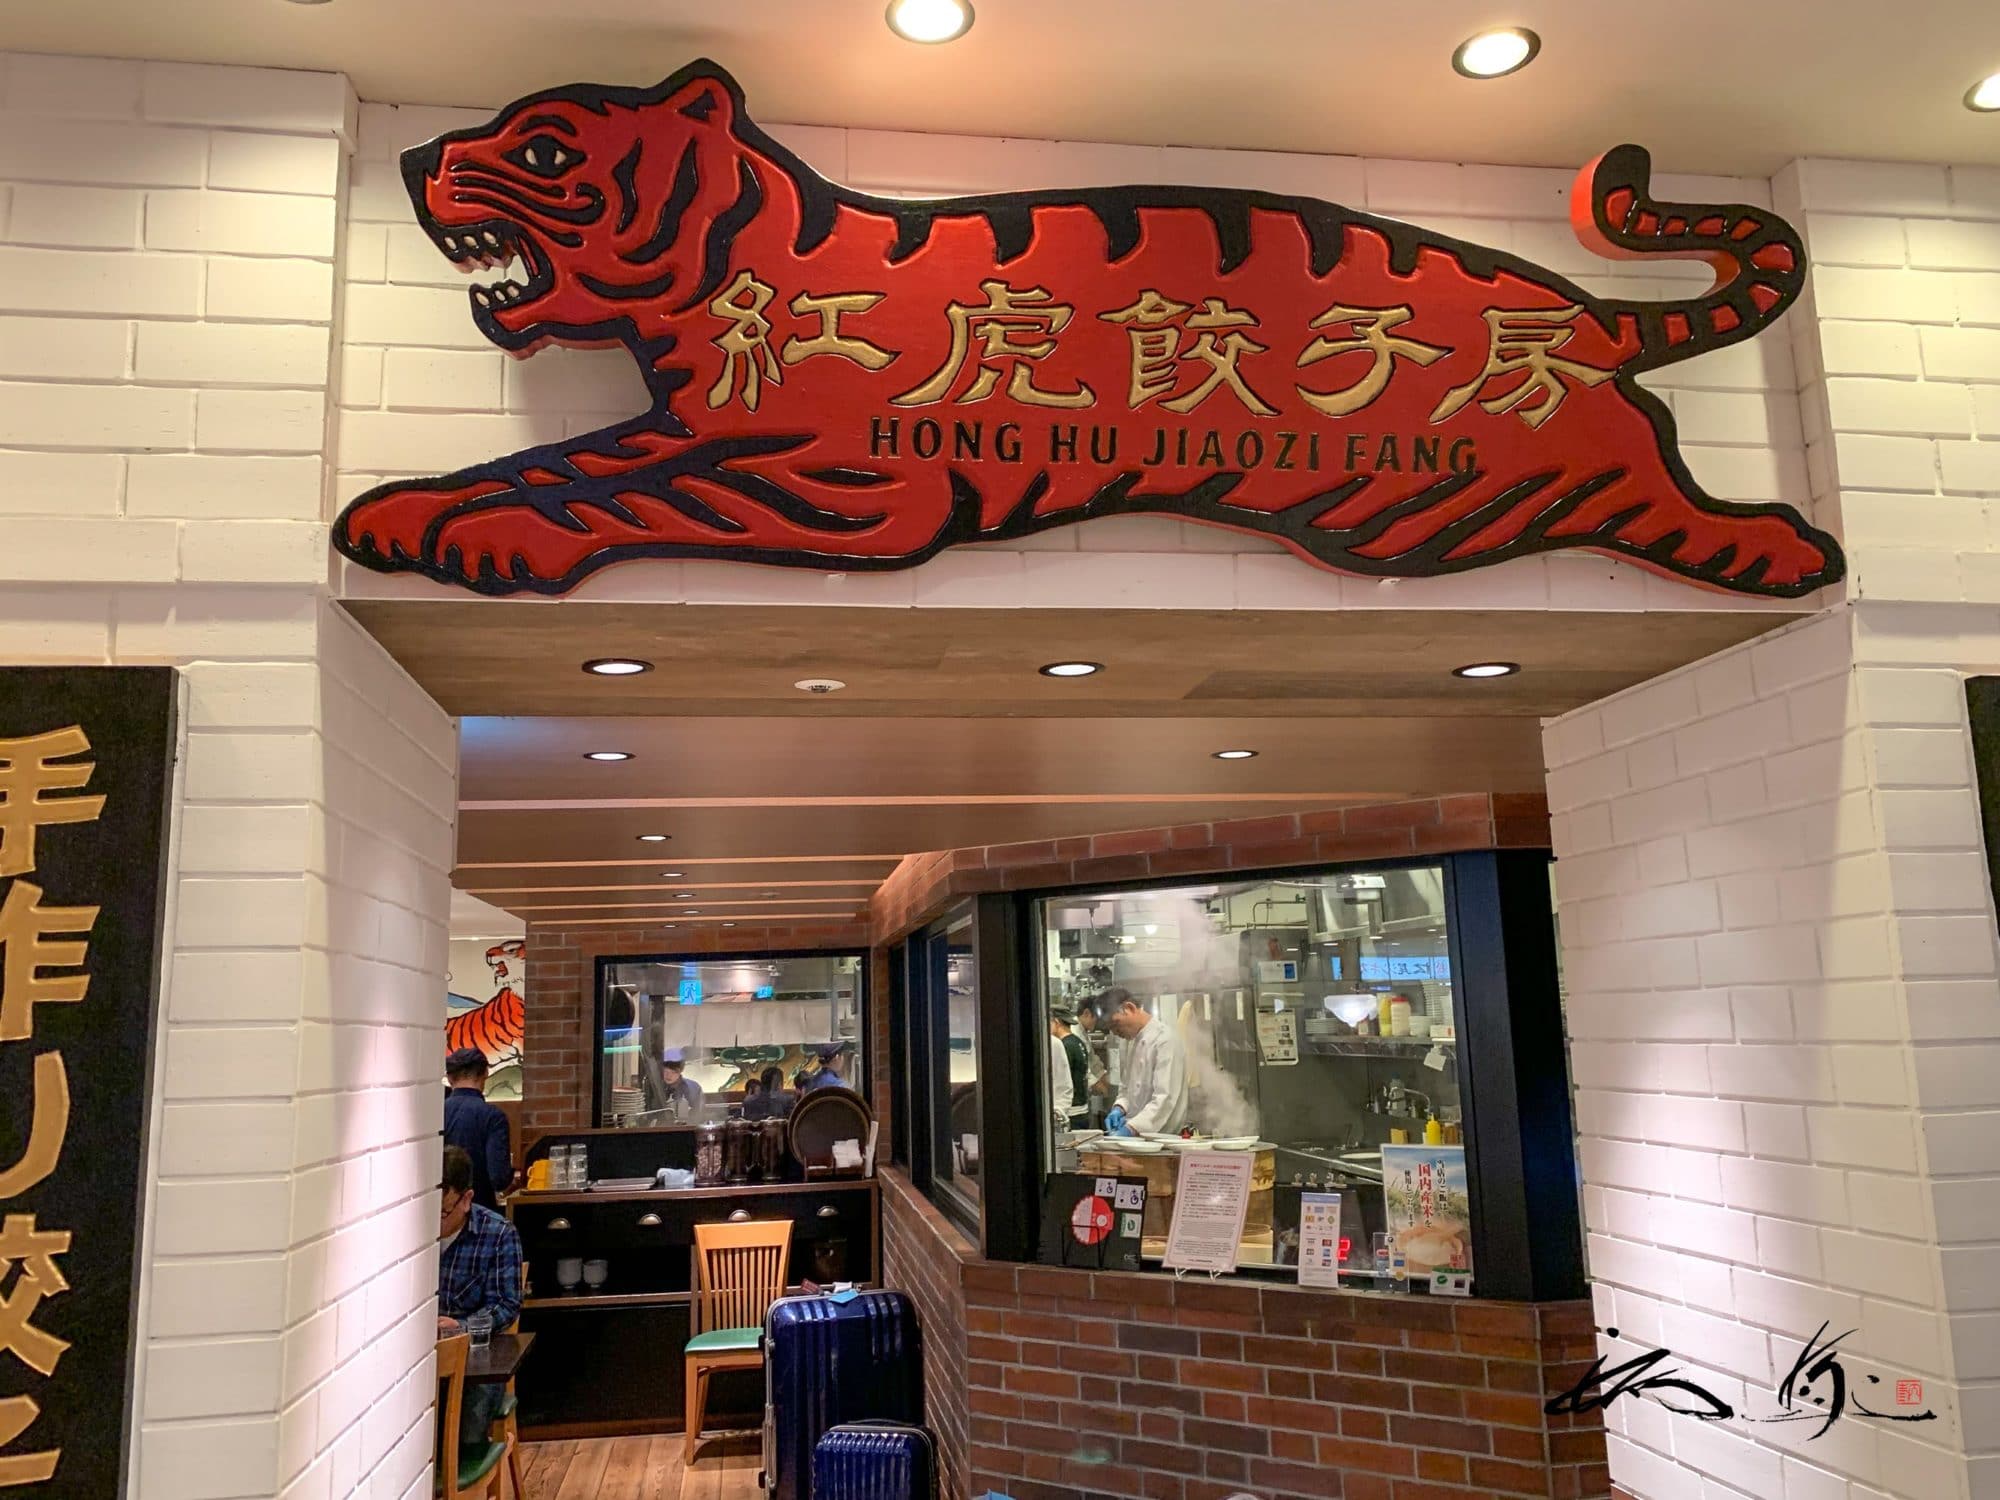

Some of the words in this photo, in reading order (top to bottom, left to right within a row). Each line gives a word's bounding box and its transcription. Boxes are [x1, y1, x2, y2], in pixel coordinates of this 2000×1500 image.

[706, 270, 1616, 430] 紅虎餃子房
[869, 417, 1024, 464] HONG
[1049, 424, 1118, 465] HU
[1143, 427, 1320, 472] JIAOZI
[1345, 433, 1476, 476] FANG
